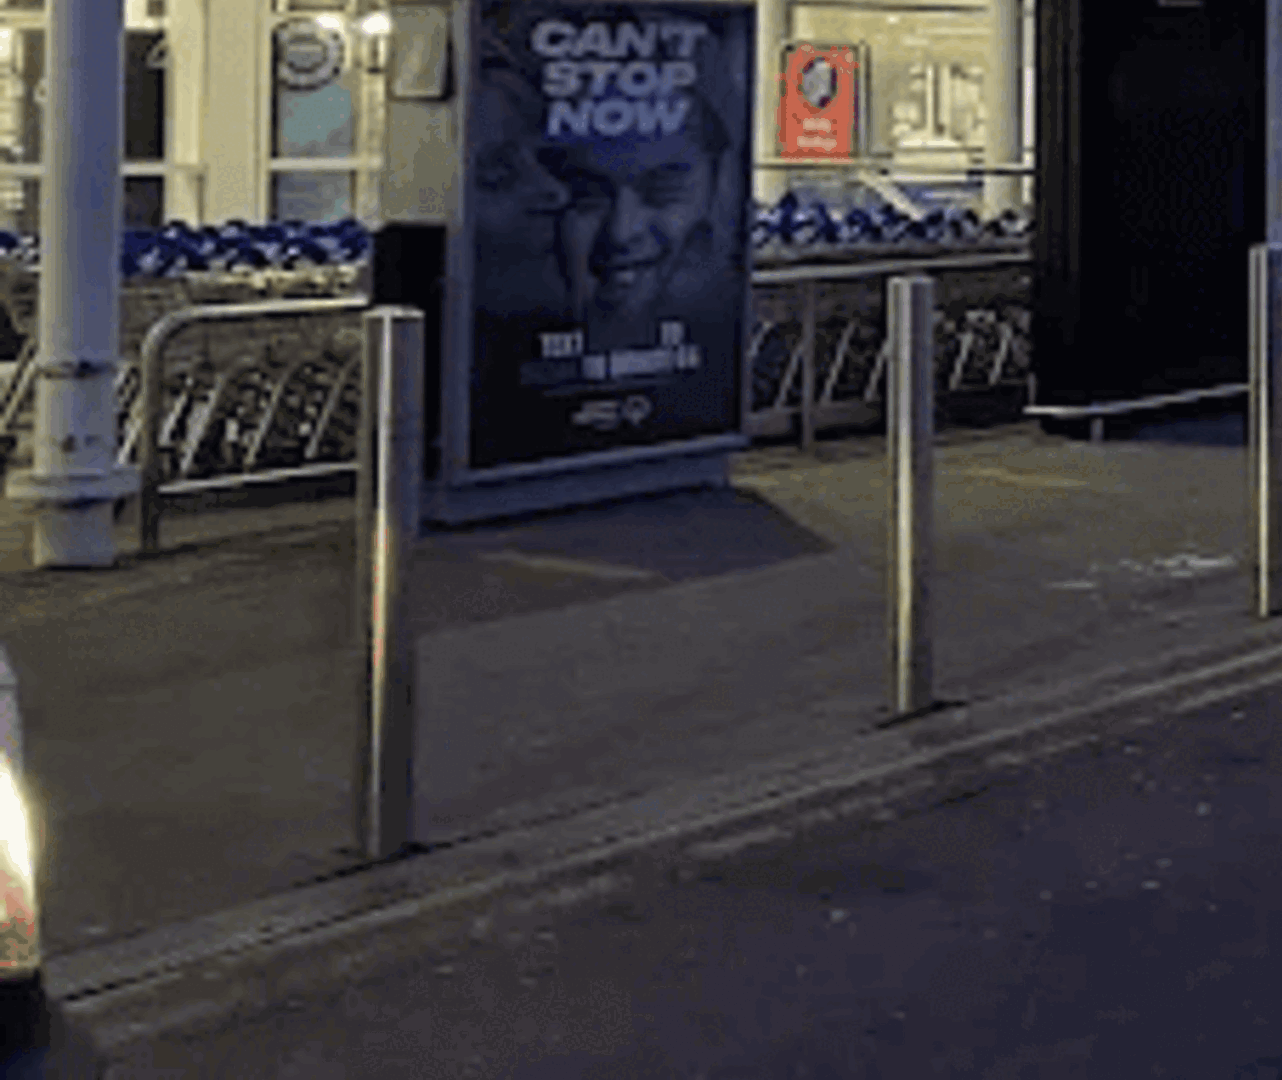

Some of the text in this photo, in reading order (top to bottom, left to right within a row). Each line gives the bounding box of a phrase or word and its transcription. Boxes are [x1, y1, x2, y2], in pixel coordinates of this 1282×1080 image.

[532, 21, 708, 58] CAN'T
[542, 60, 697, 97] STOP
[548, 98, 691, 136] NOW
